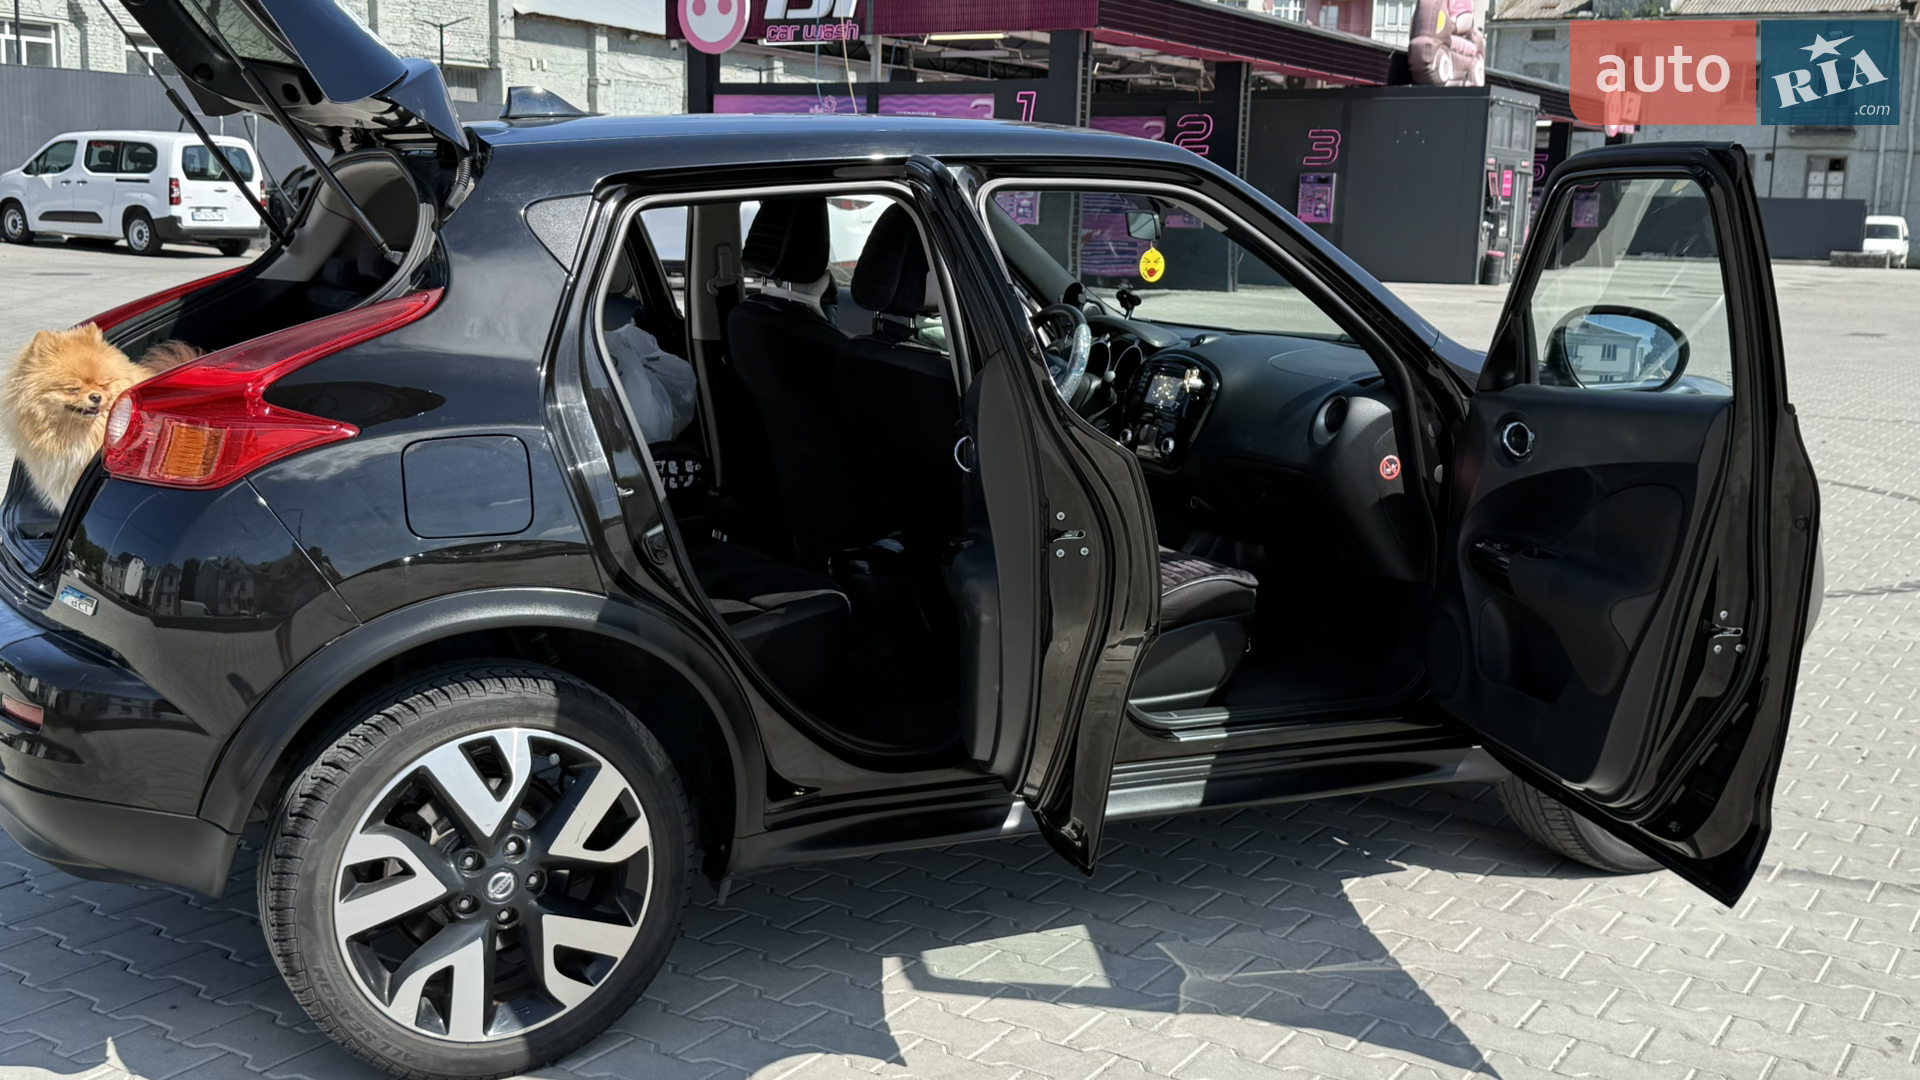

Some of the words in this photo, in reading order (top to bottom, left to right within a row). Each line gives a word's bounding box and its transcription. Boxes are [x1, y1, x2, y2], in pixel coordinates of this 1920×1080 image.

[766, 25, 800, 41] car
[803, 20, 859, 41] wash
[1016, 91, 1037, 122] 1
[1173, 114, 1213, 157] 2
[1303, 128, 1342, 166] 3
[312, 966, 378, 1043] SEASON
